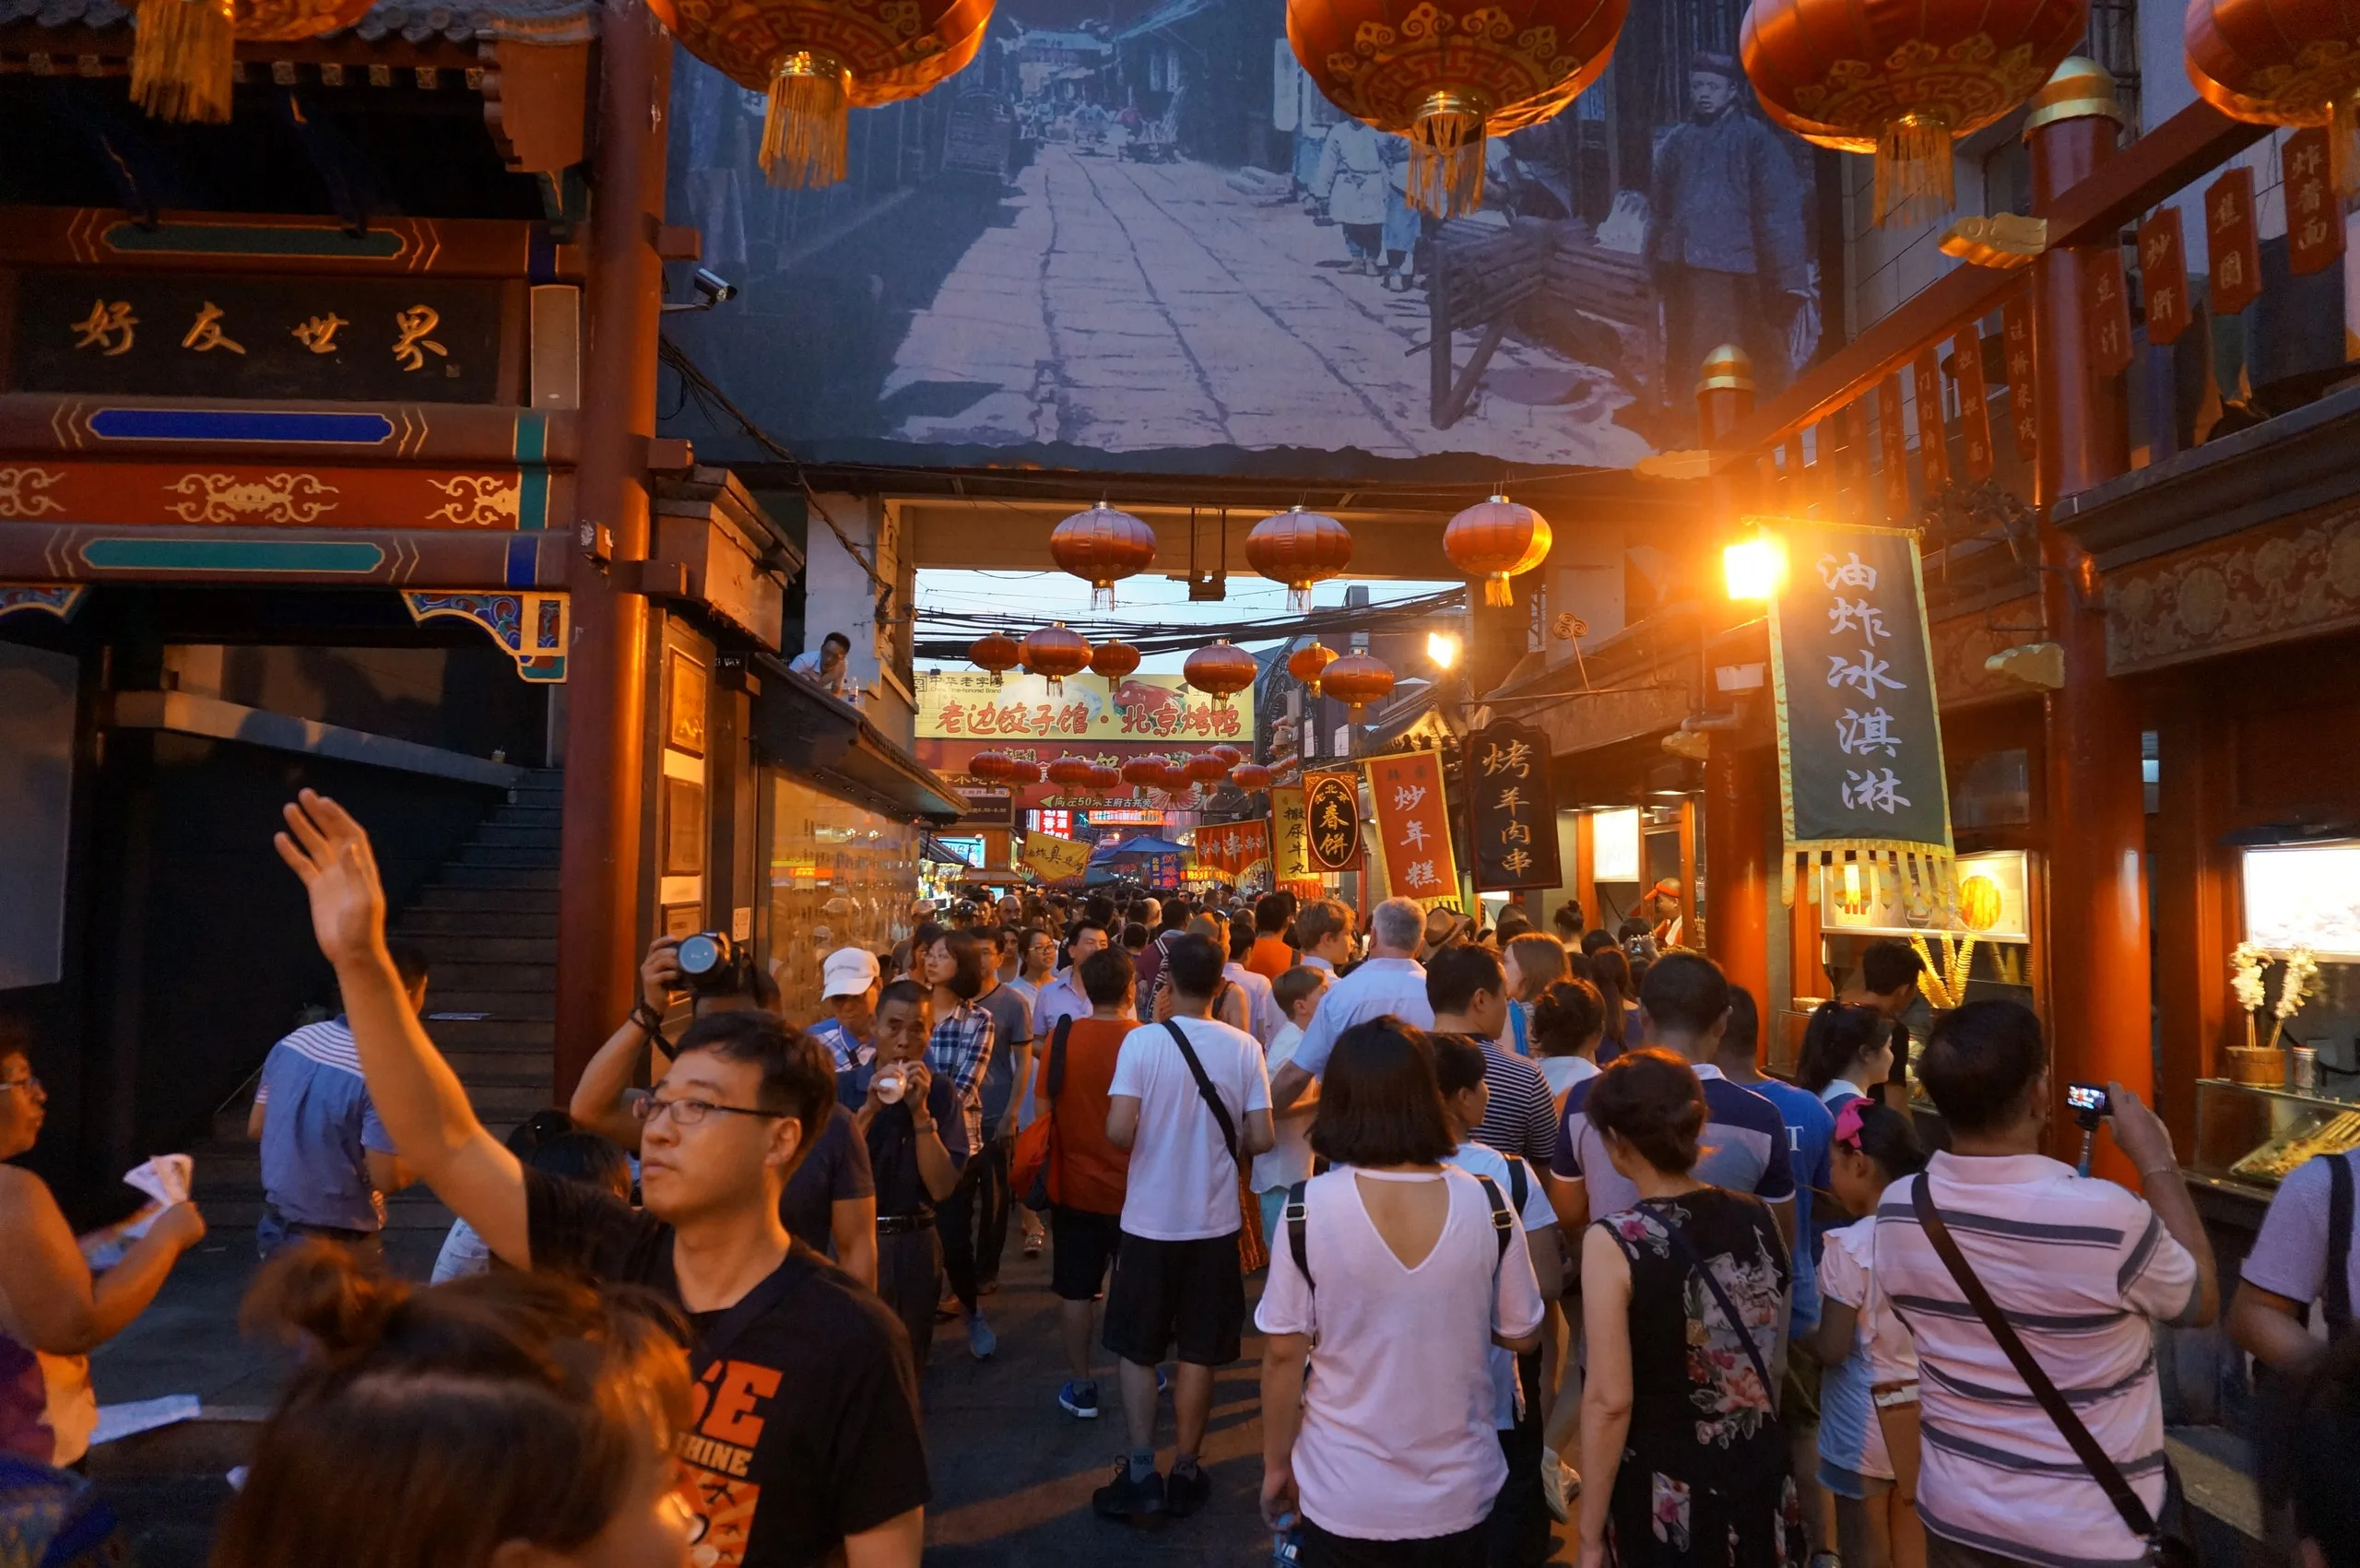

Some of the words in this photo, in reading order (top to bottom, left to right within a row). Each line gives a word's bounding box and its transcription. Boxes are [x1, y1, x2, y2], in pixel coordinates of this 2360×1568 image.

[71, 300, 448, 371] 好友世界
[1816, 552, 1911, 815] 油炸冰淇淋
[1394, 784, 1442, 890] 炒年糕
[1481, 738, 1534, 878] 烤羊肉串
[678, 1431, 753, 1478] HINE
